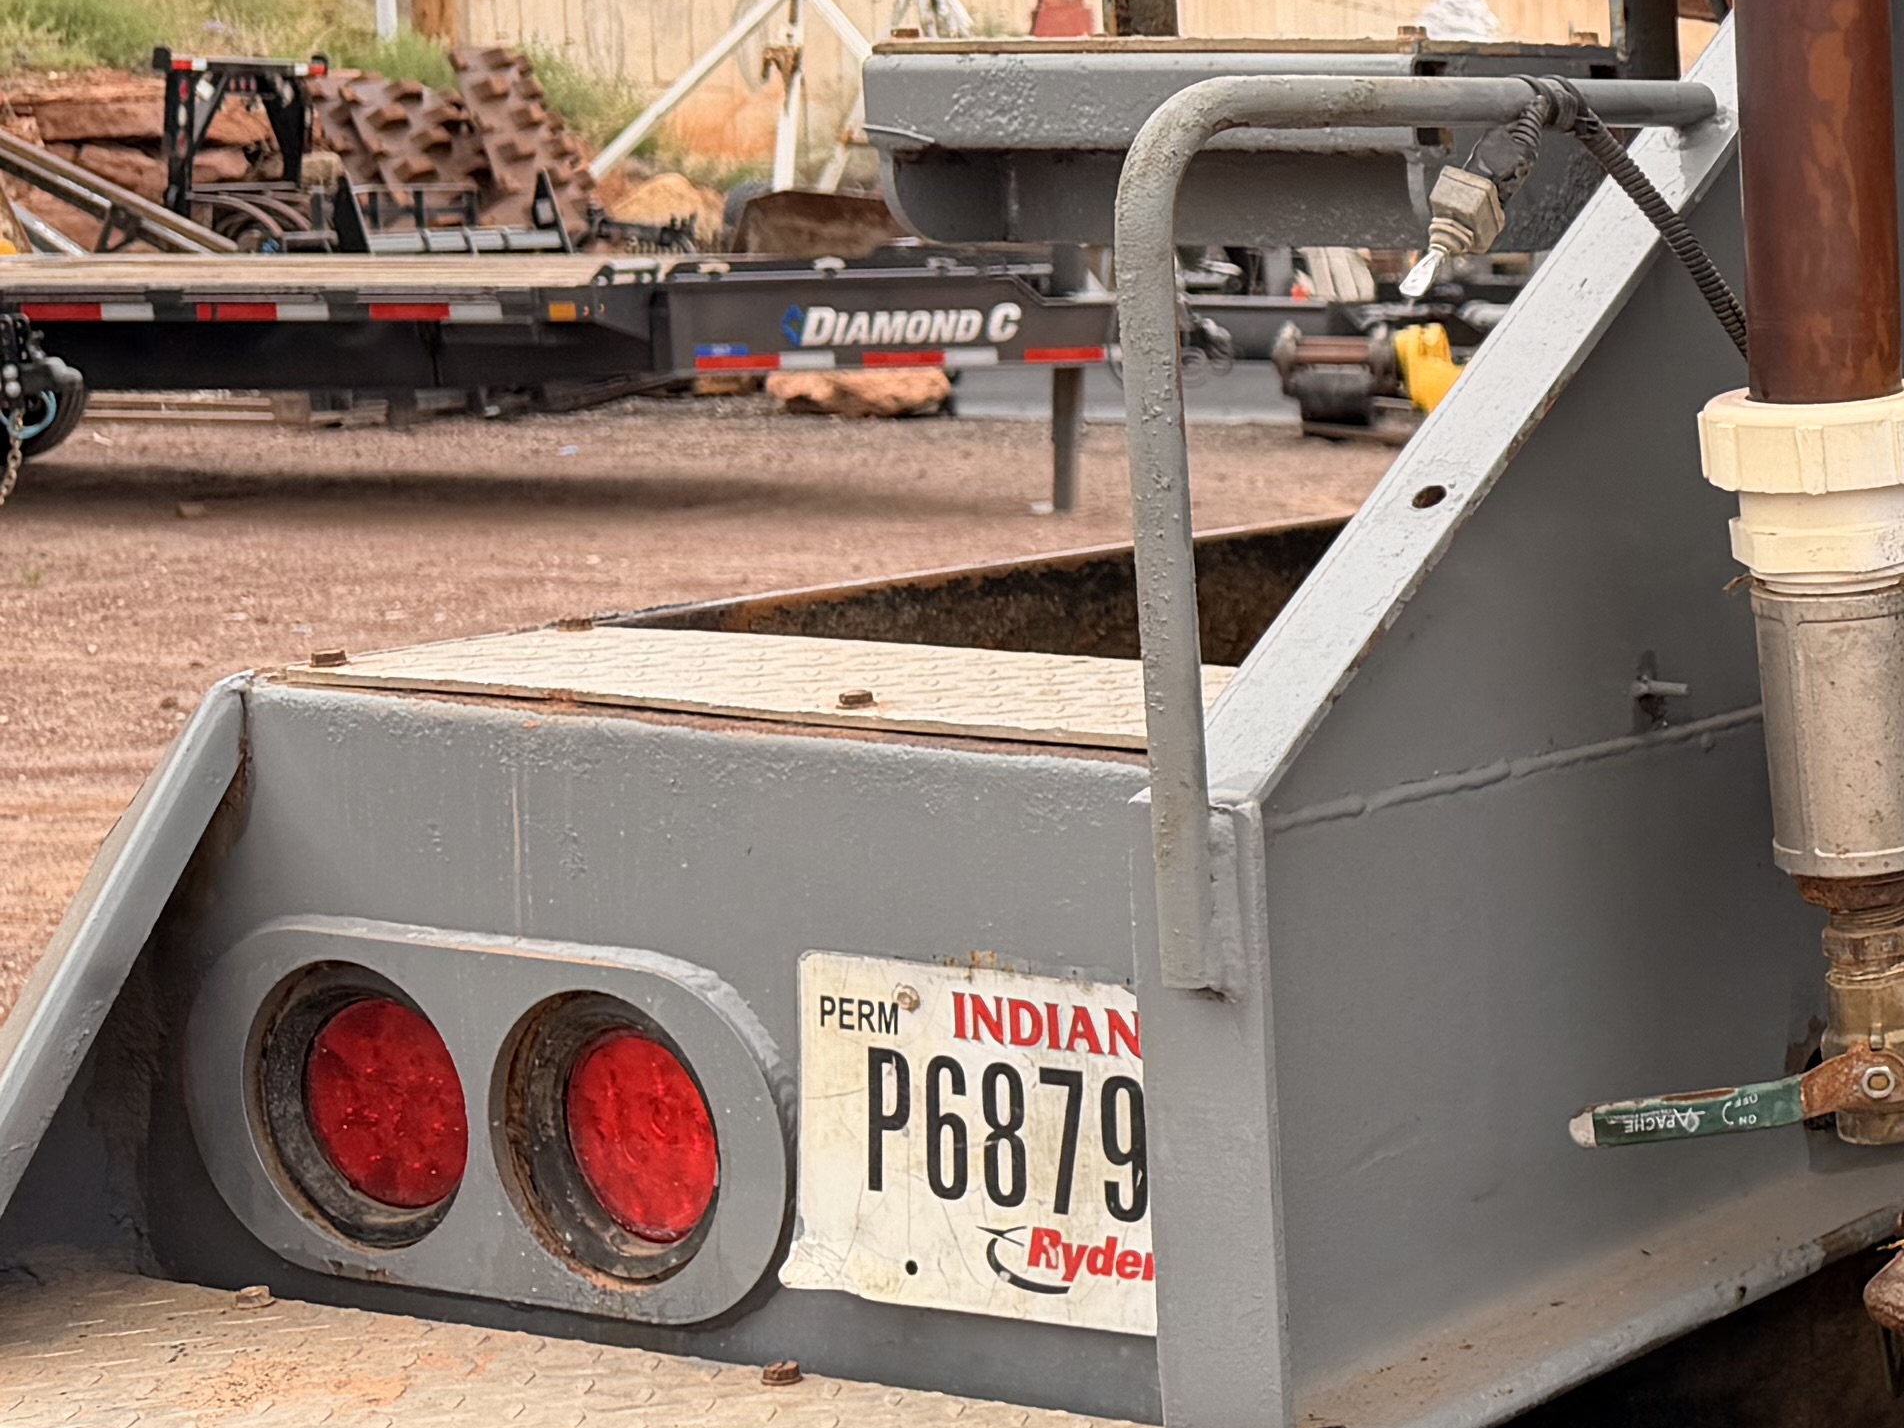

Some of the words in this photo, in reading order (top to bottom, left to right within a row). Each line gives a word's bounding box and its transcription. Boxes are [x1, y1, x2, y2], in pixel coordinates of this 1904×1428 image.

[801, 306, 983, 347] DIAMOND
[986, 302, 1022, 344] C
[819, 994, 900, 1036] PERM
[951, 990, 1143, 1061] INDIAN
[1735, 1092, 1759, 1108] OFF
[867, 1046, 1149, 1224] P6879
[1623, 1107, 1698, 1134] APACHE
[1738, 1113, 1757, 1126] ON
